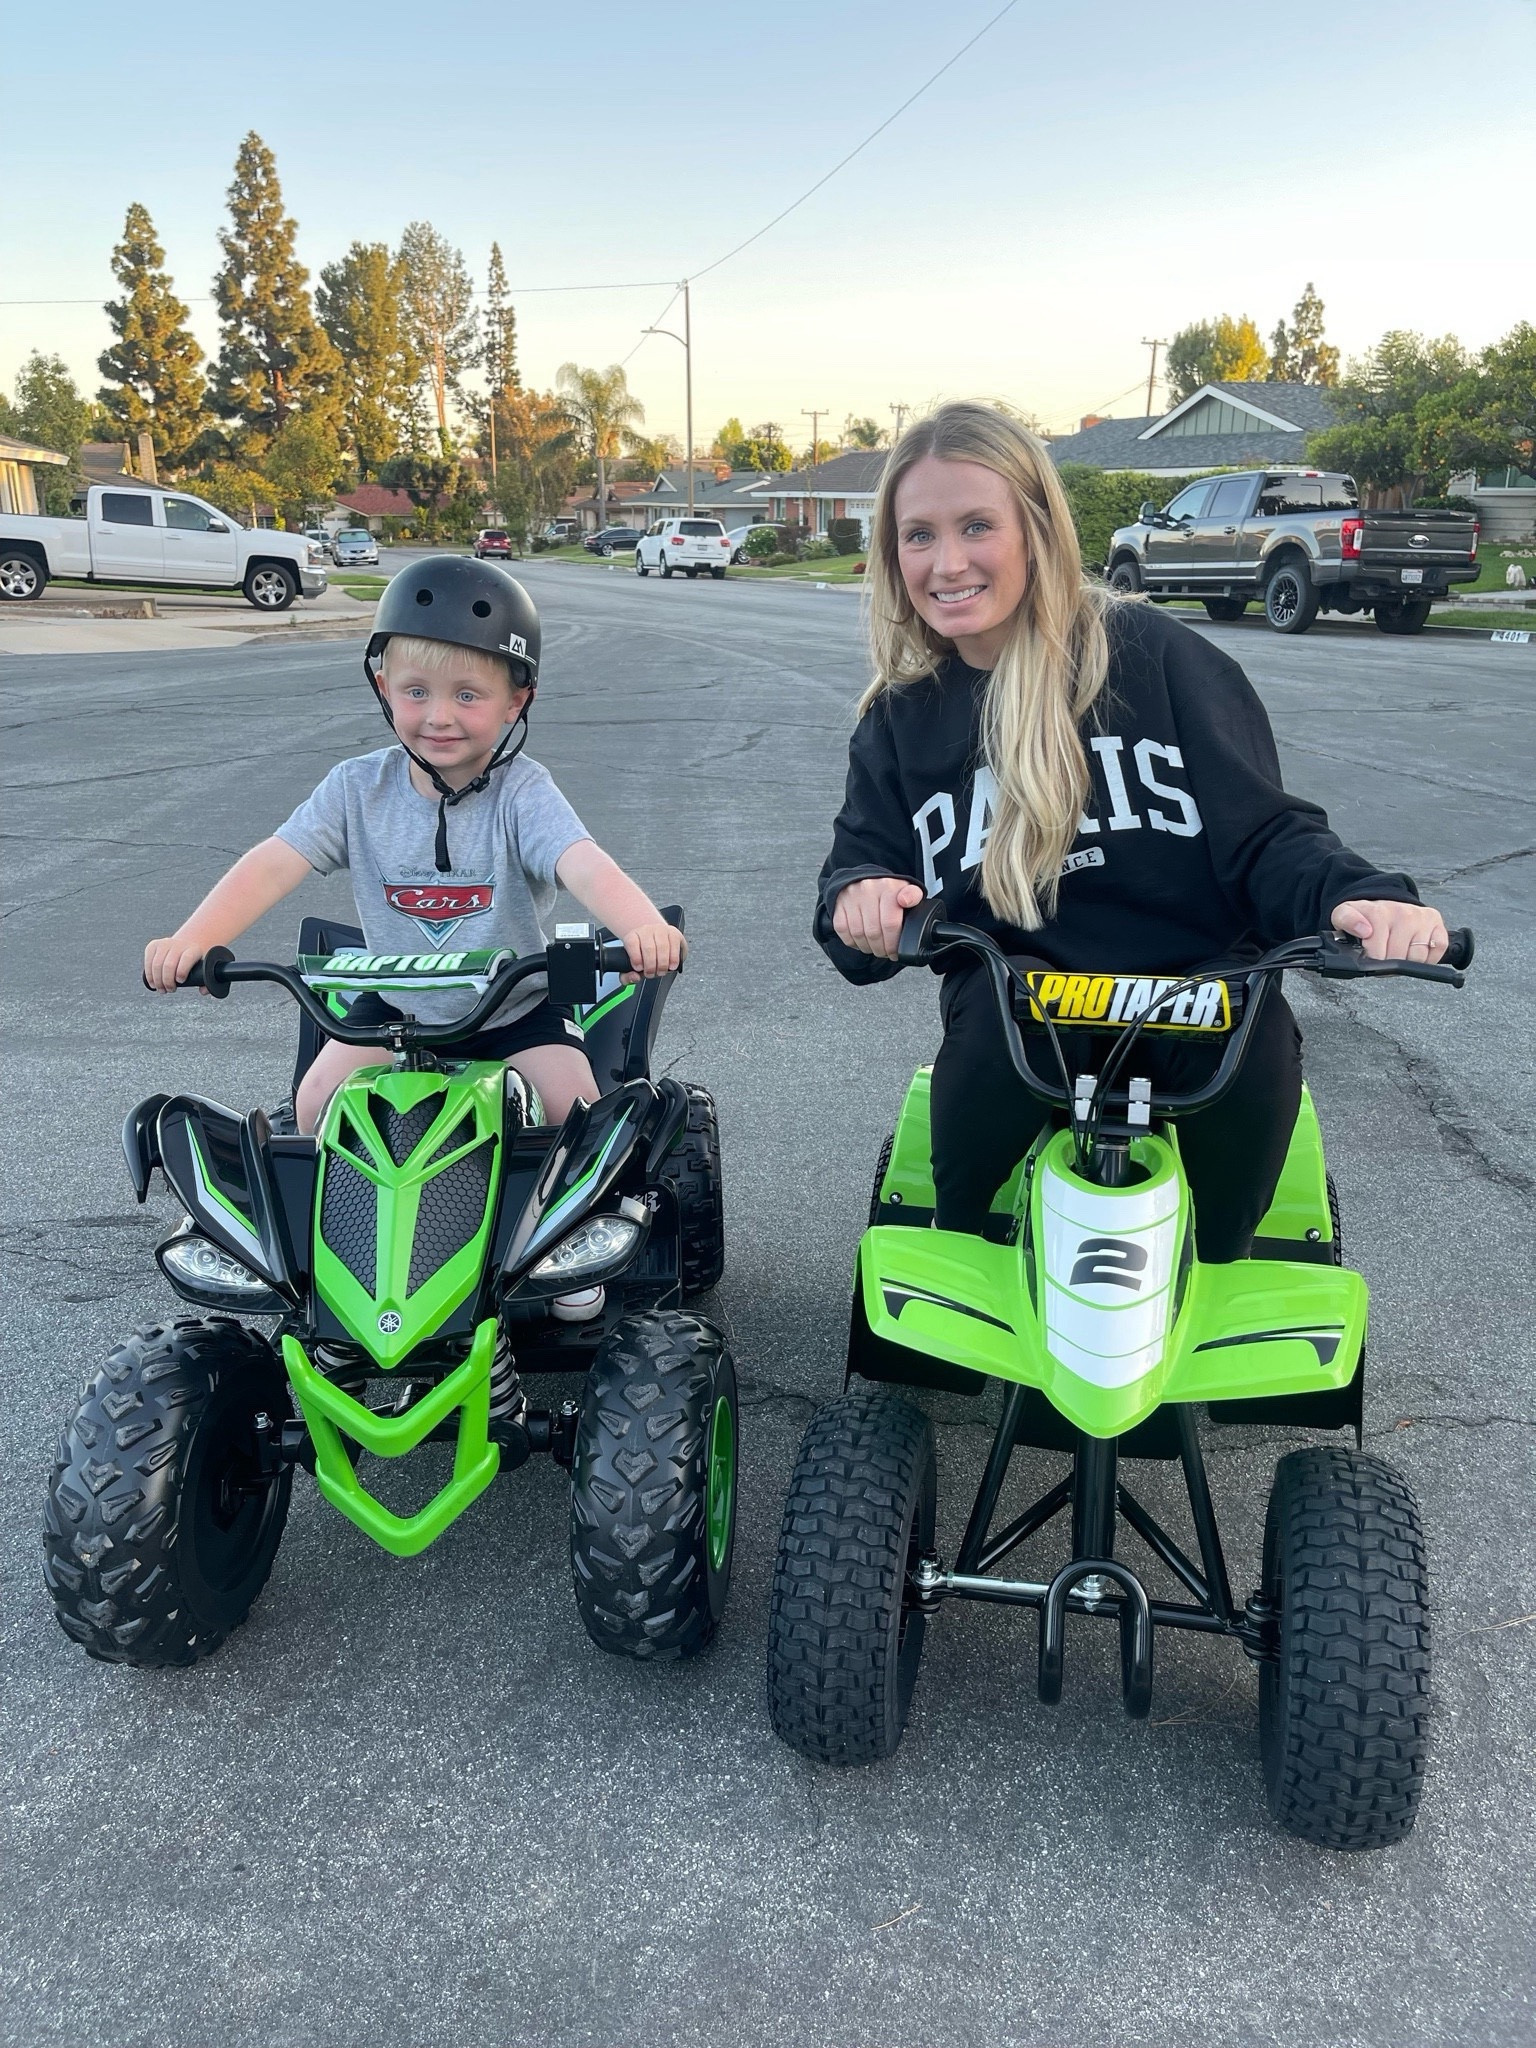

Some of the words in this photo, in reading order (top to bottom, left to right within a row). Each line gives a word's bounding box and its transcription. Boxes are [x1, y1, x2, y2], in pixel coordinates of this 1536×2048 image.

[1499, 630, 1520, 641] 4401
[912, 735, 1203, 899] PAIS
[390, 889, 484, 910] Cars
[322, 952, 469, 972] RAPTOR
[1069, 1237, 1148, 1292] 2
